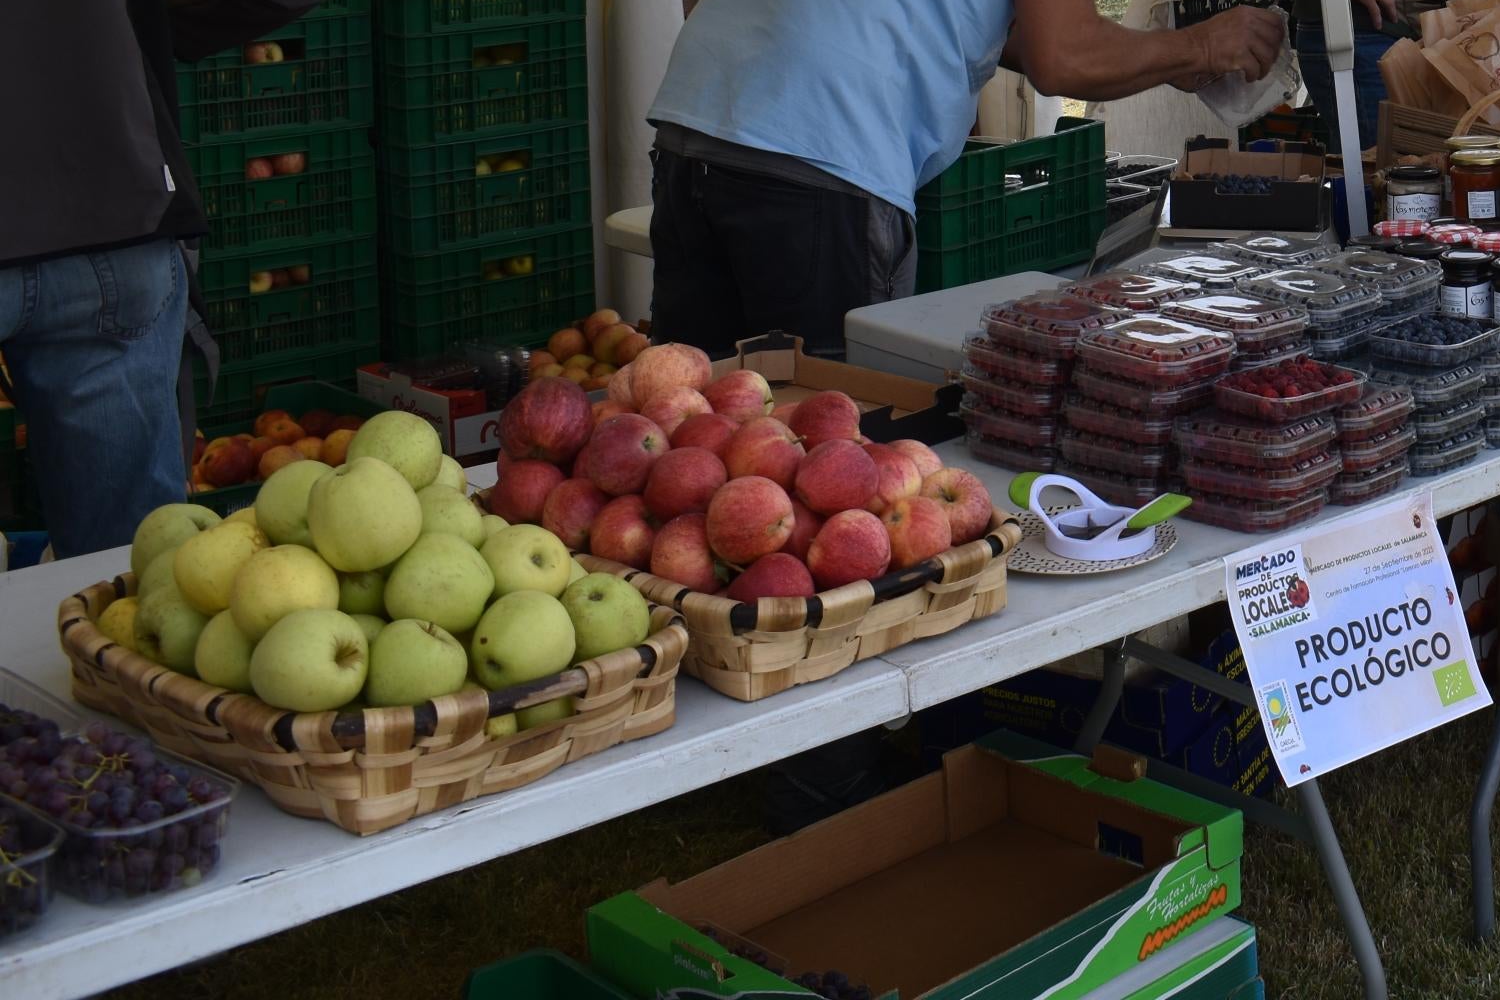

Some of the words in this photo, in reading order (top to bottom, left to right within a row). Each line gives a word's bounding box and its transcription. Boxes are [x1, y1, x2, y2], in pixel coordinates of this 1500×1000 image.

[1236, 550, 1296, 580] MERCADO
[1309, 560, 1335, 574] MERCADO
[1342, 550, 1371, 563] PRODUCTOS
[1371, 543, 1392, 555] LOCALES
[1400, 531, 1428, 545] SALAMANCA
[1261, 572, 1271, 582] DE
[1241, 592, 1293, 625] LOCALE
[1295, 597, 1432, 669] PRODUCTO
[1295, 631, 1451, 713] ECOLÓGICO
[1146, 883, 1185, 921] Frutas
[1161, 874, 1218, 922] Hortalizas
